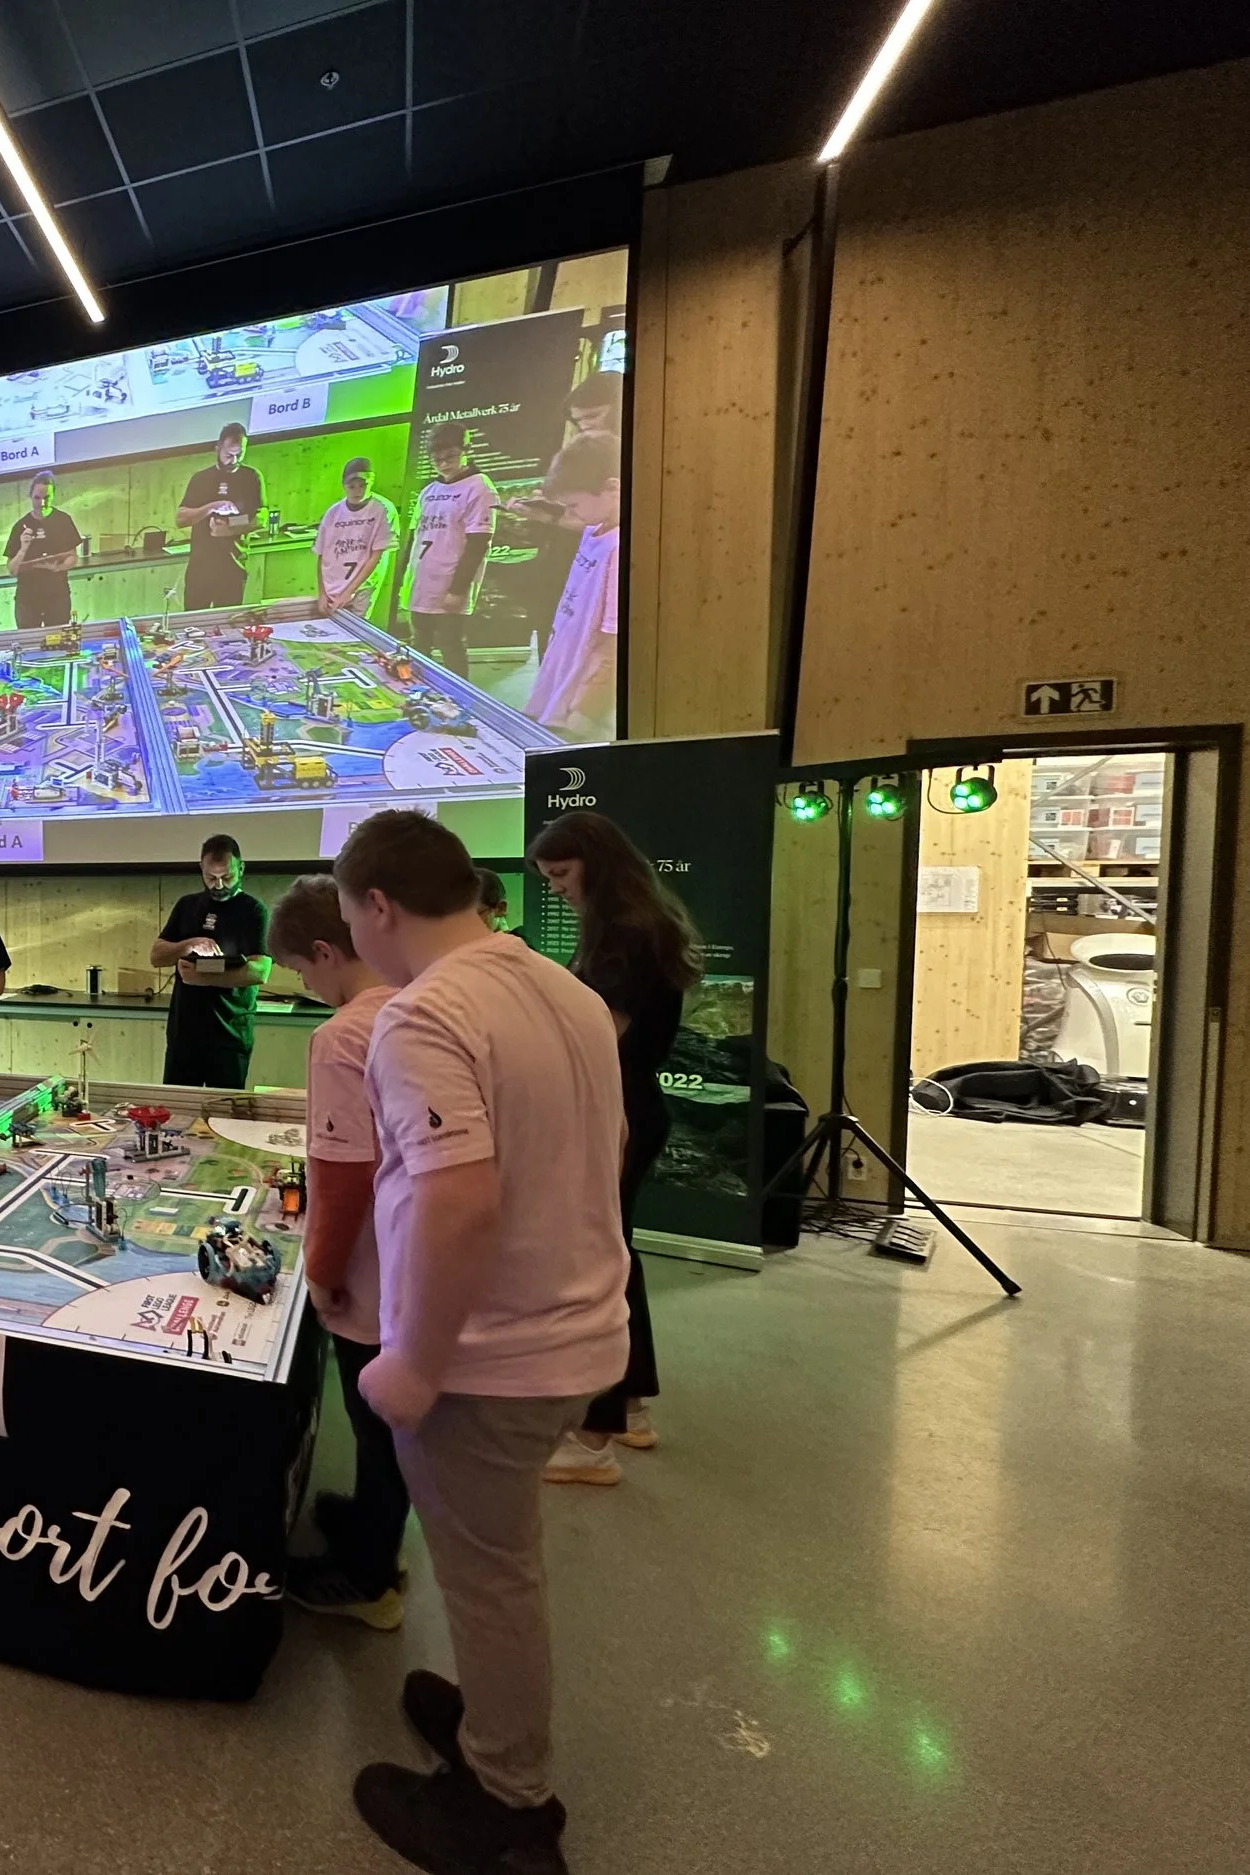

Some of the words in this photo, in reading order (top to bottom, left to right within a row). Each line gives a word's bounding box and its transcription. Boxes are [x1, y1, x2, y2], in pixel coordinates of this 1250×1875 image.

[431, 364, 465, 377] Hydro
[268, 398, 299, 415] Bord
[302, 397, 311, 409] B
[0, 447, 28, 461] Bord
[31, 446, 40, 457] A
[419, 540, 434, 560] 7
[343, 562, 358, 580] 7
[547, 793, 597, 810] Hydro
[11, 835, 23, 848] A
[657, 860, 673, 872] 75
[675, 859, 692, 872] år
[656, 1072, 704, 1090] 022
